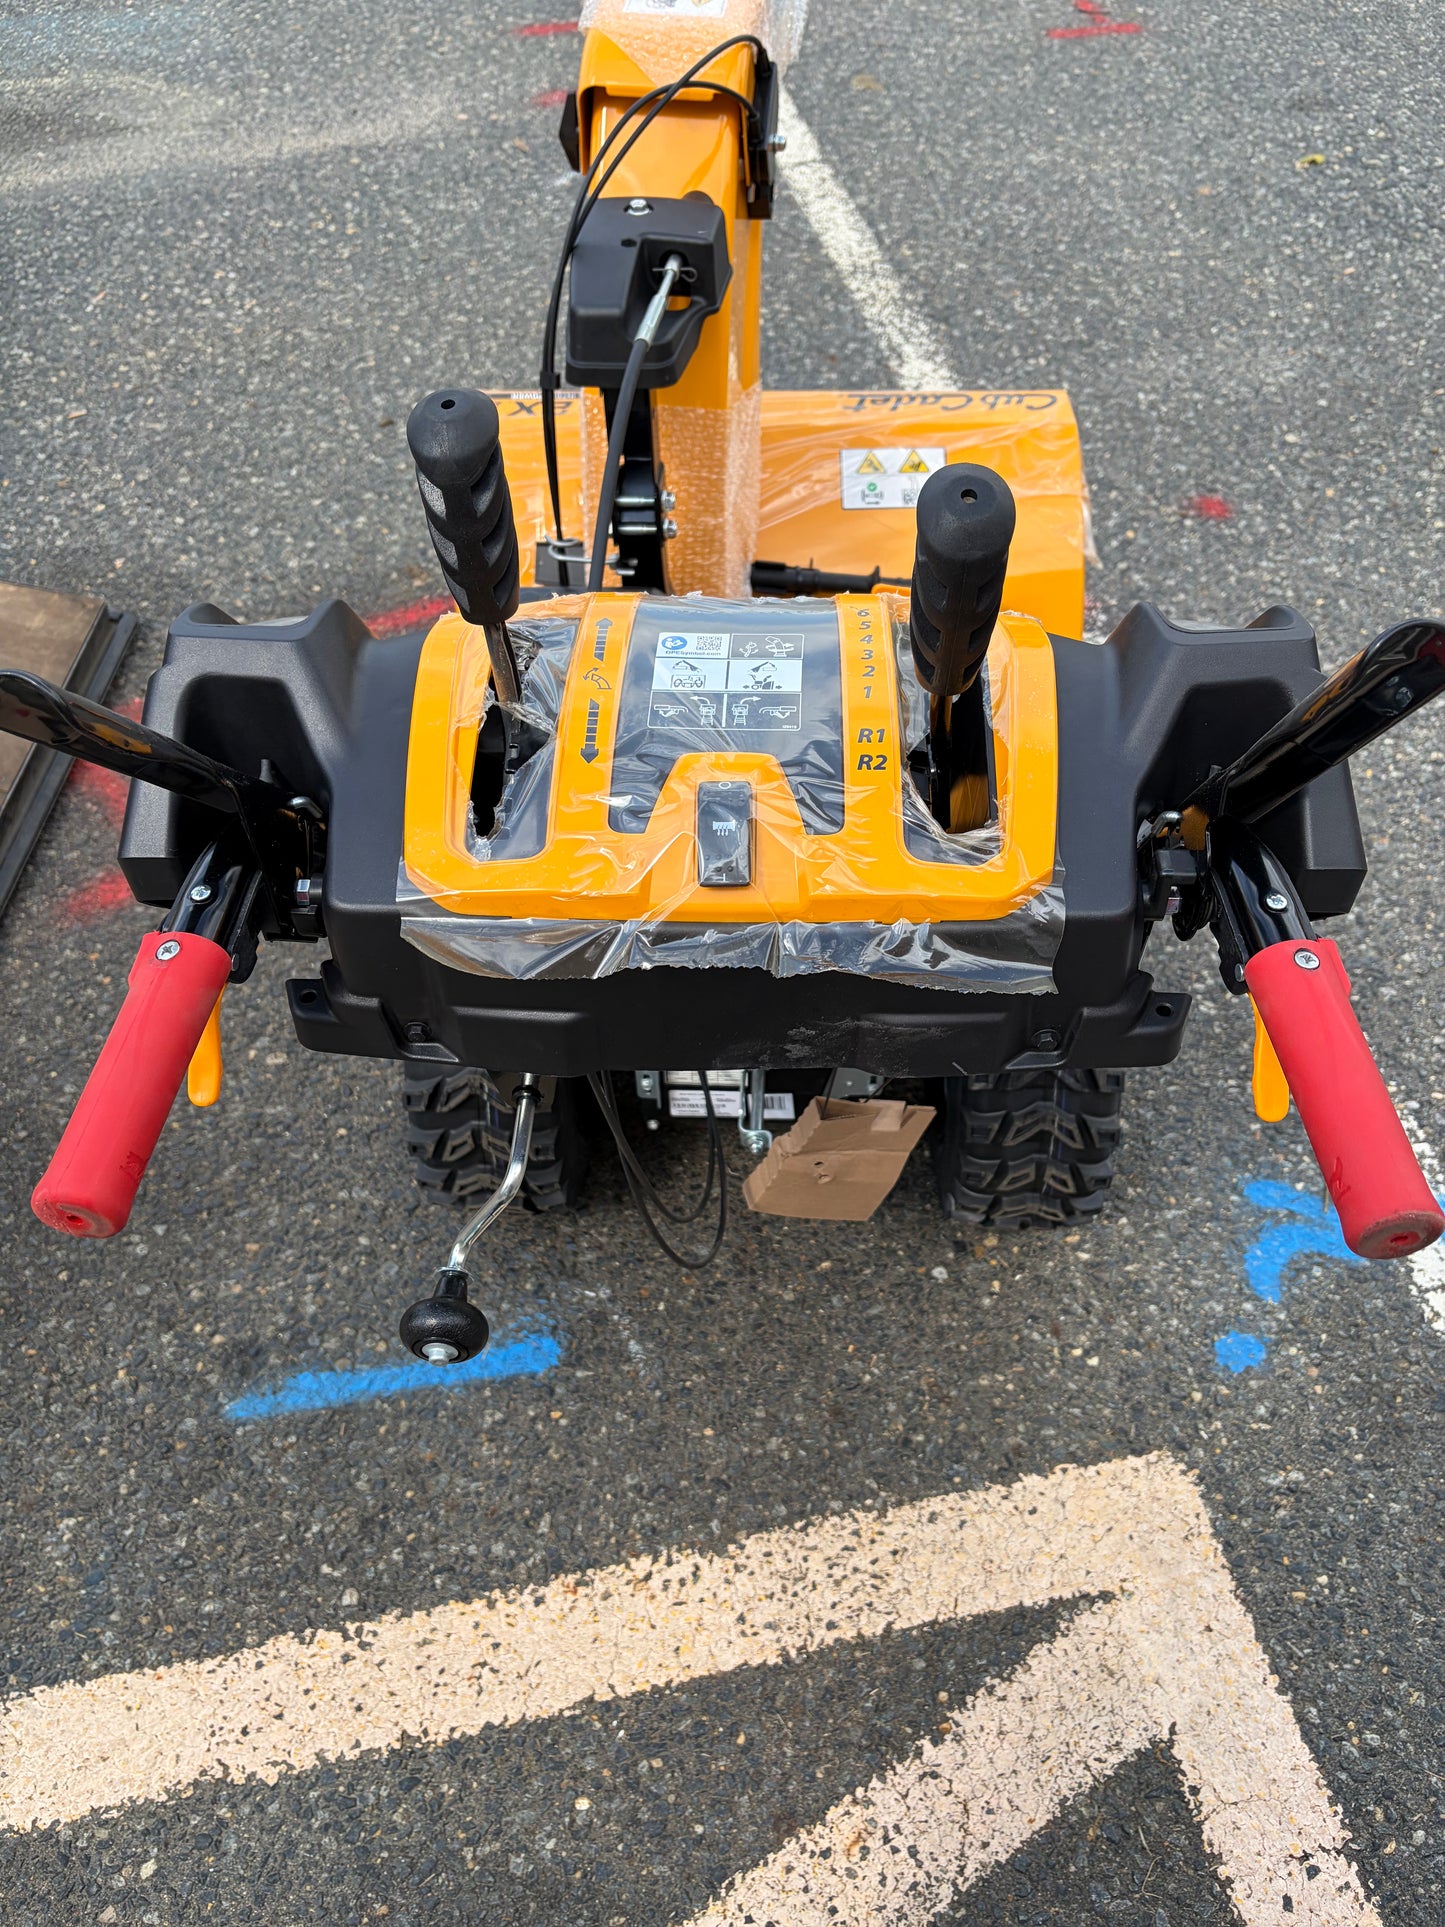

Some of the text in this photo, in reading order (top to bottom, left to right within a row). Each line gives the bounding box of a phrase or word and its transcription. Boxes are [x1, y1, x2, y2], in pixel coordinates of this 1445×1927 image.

[843, 393, 1057, 412] Cub Cadet
[857, 609, 870, 617] 6
[859, 621, 871, 630] 5
[860, 634, 874, 644] 4
[861, 650, 874, 660] 3
[862, 665, 876, 677] 2
[863, 686, 872, 699] 1
[857, 728, 885, 743] R1
[857, 754, 888, 771] R2
